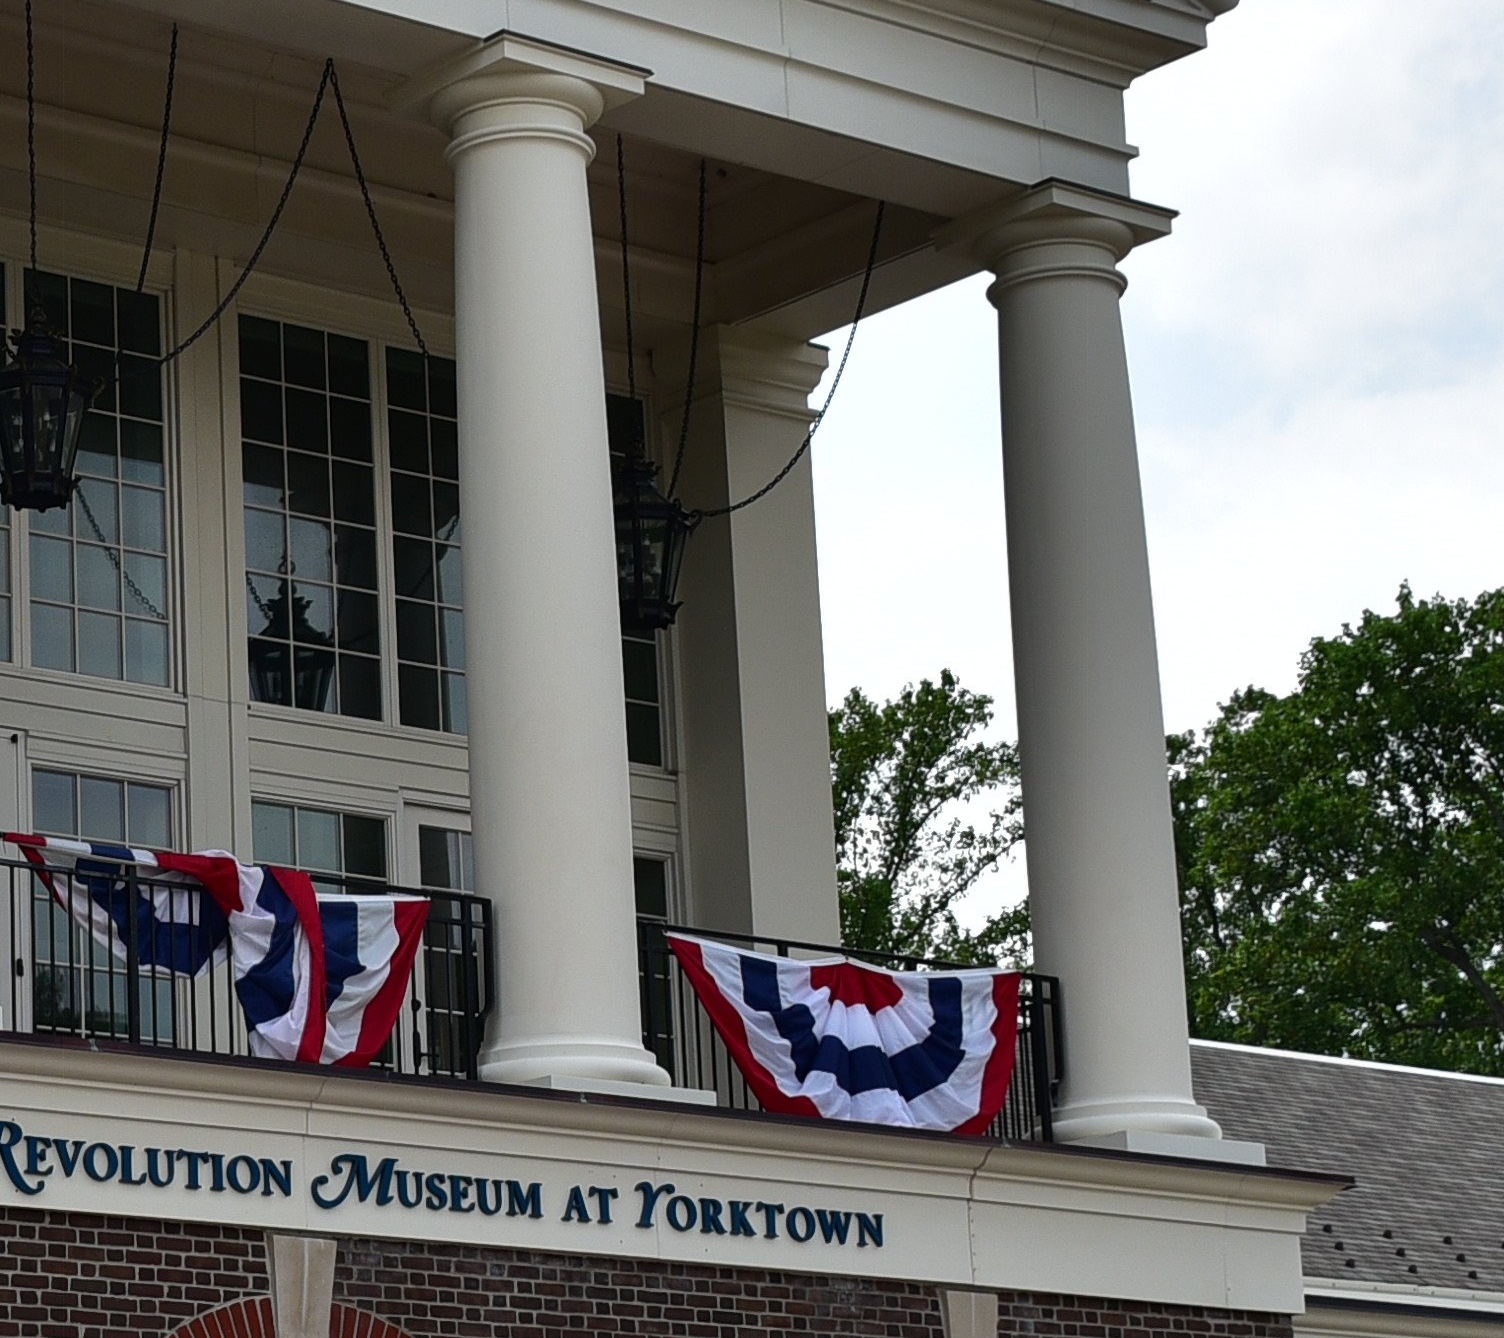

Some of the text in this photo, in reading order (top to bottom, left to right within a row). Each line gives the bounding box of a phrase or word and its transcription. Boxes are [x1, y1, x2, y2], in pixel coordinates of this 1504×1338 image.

[311, 1153, 543, 1219] MUSEUM
[561, 1186, 619, 1224] AT
[635, 1181, 884, 1248] YORKTOWN
